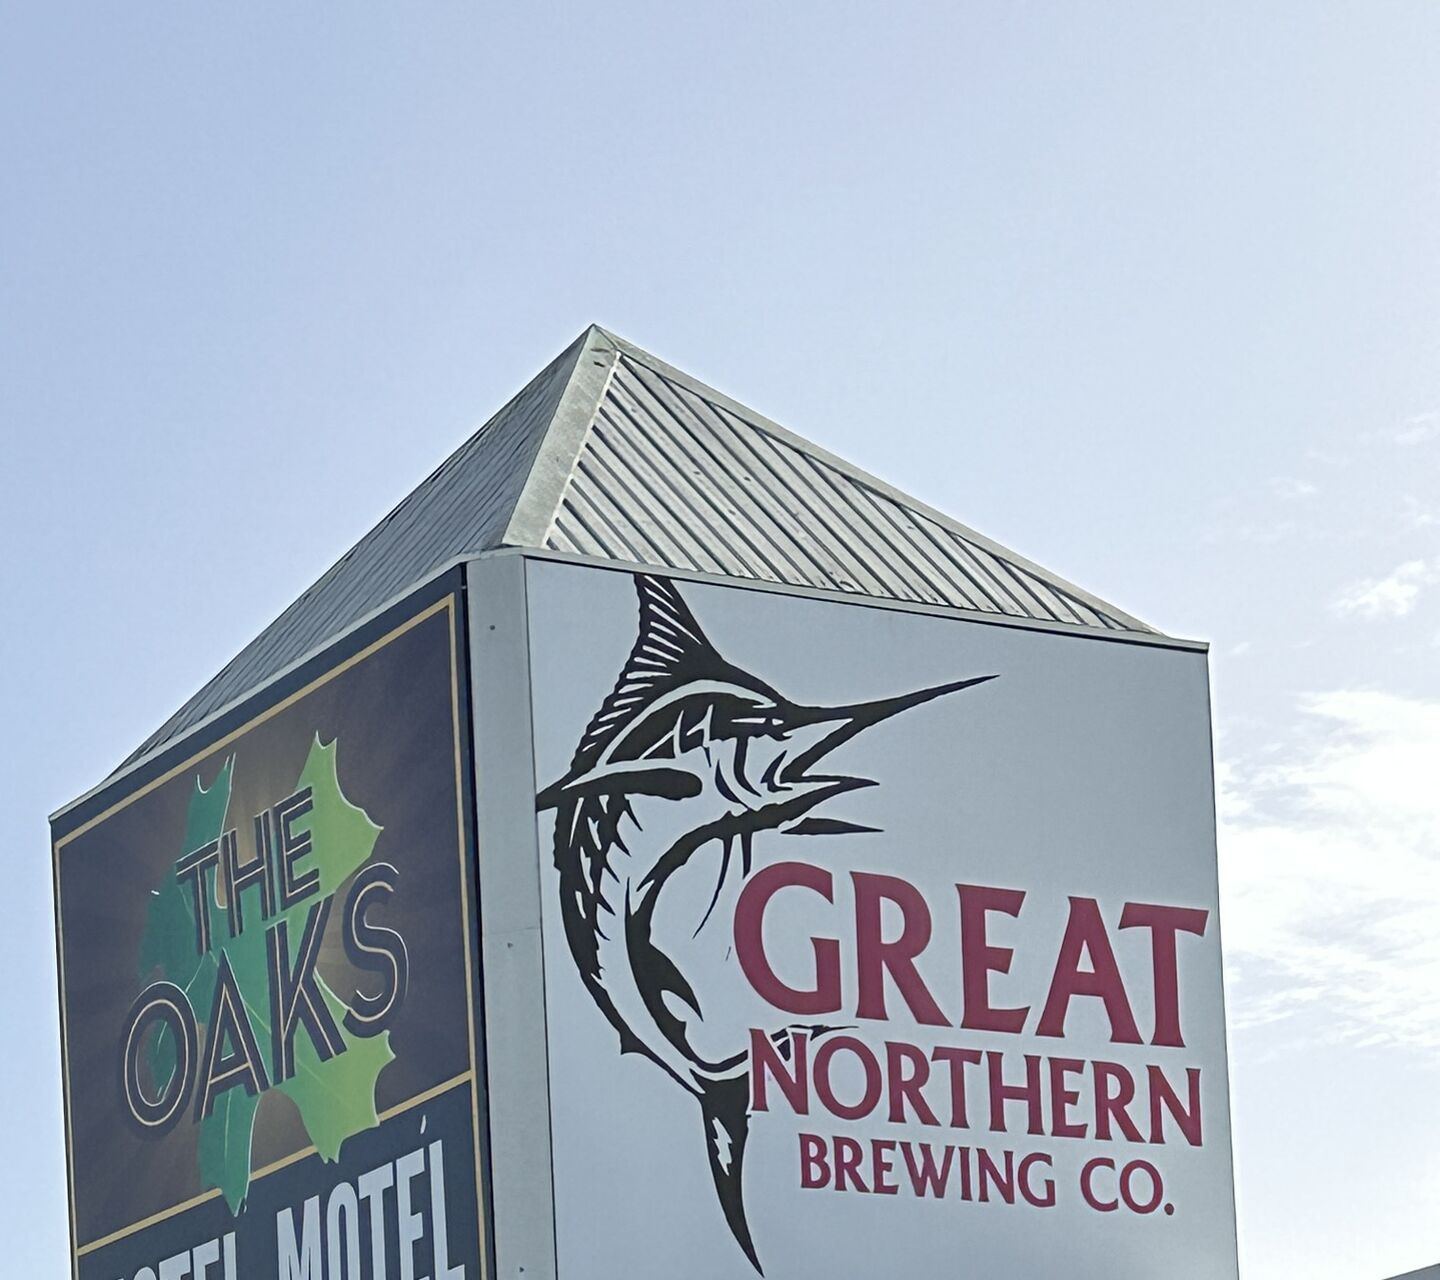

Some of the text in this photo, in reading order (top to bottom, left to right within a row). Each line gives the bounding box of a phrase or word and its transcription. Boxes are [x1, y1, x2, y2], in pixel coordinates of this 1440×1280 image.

[175, 786, 321, 957] THE
[733, 860, 1210, 1049] GREAT
[120, 862, 409, 1136] OAKS
[748, 1027, 1204, 1148] NORTHERN
[798, 1132, 1176, 1217] BREWING CO.
